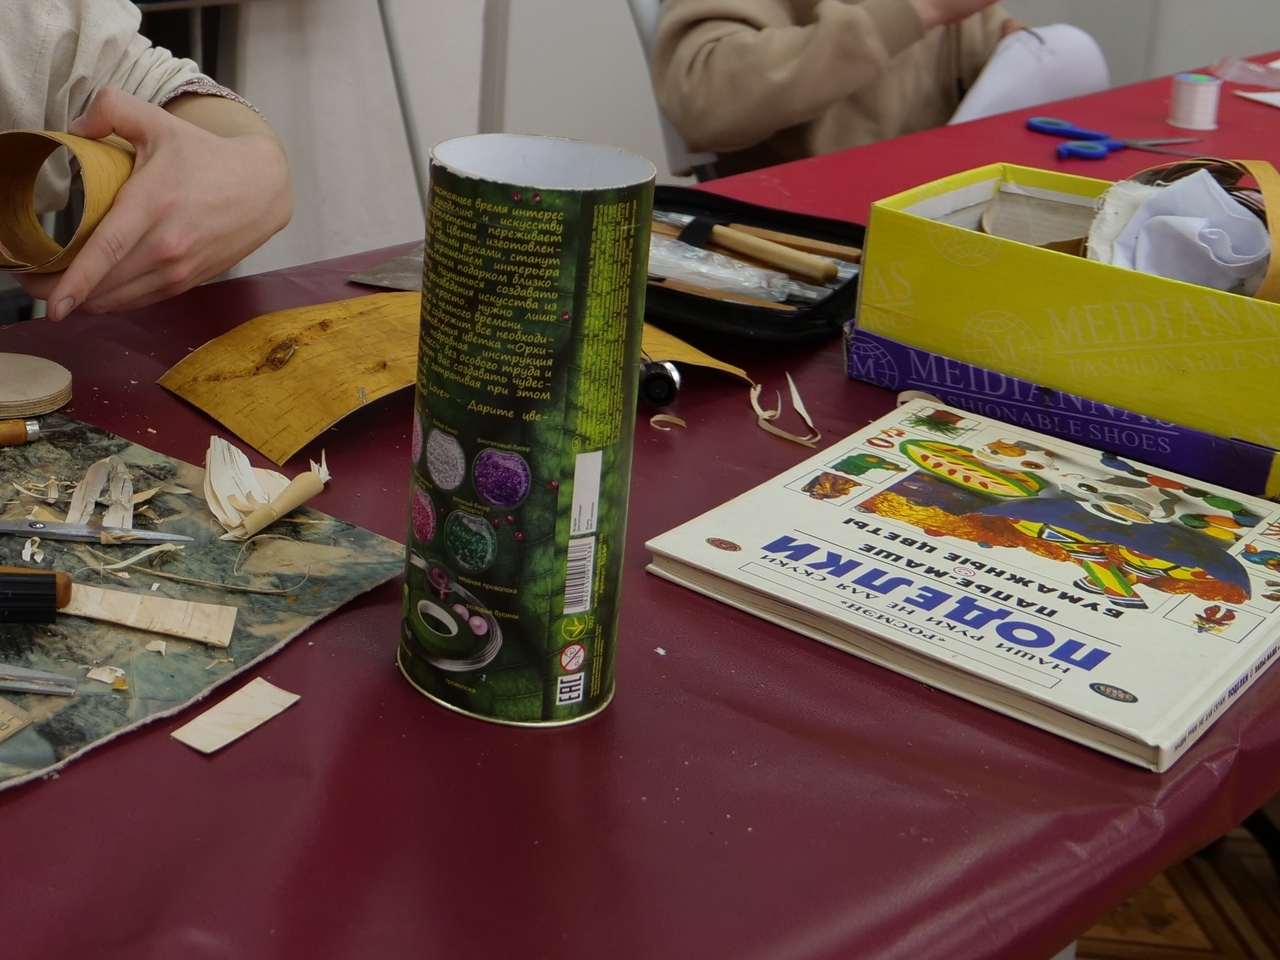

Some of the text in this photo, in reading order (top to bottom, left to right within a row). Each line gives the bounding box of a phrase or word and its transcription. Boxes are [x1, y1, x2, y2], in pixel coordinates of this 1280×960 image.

[475, 198, 508, 215] время
[512, 207, 564, 222] интерес
[487, 226, 562, 243] переживает
[500, 218, 564, 234] искусству
[462, 242, 506, 261] руками,
[510, 252, 561, 268] станут
[486, 238, 562, 254] изготовлен-
[457, 264, 560, 288] подарком близко-
[493, 261, 560, 279] интерьера
[478, 292, 539, 309] искусства
[544, 302, 557, 311] из
[496, 284, 559, 300] создавать
[478, 303, 513, 318] нужно
[524, 312, 557, 321] лишь
[474, 313, 524, 331] времени.
[462, 332, 501, 349] цветка
[475, 323, 492, 336] все
[496, 330, 555, 344] необходи-
[444, 343, 457, 358] без
[460, 354, 498, 371] особого
[502, 363, 541, 379] труда
[545, 370, 552, 378] и
[482, 349, 554, 367] инструкция
[437, 352, 552, 389] Вас создавать чудес-
[487, 382, 509, 396] при
[515, 389, 551, 400] этом
[467, 399, 514, 419] Дарите
[1088, 422, 1172, 455] SHOES
[842, 517, 1125, 619] БУМАЖНЫЕ ЦВЕТЫ
[482, 581, 518, 595] проволока
[858, 543, 1059, 618] ПАПЬЕ-МАШЕ
[760, 534, 1112, 672] ПОДЕЛКИ
[494, 610, 520, 621] бусины
[759, 554, 1071, 674] НАШИ РУКИ НЕ ДЛЯ СКУКИ
[840, 600, 946, 642] «РОСМЭН»
